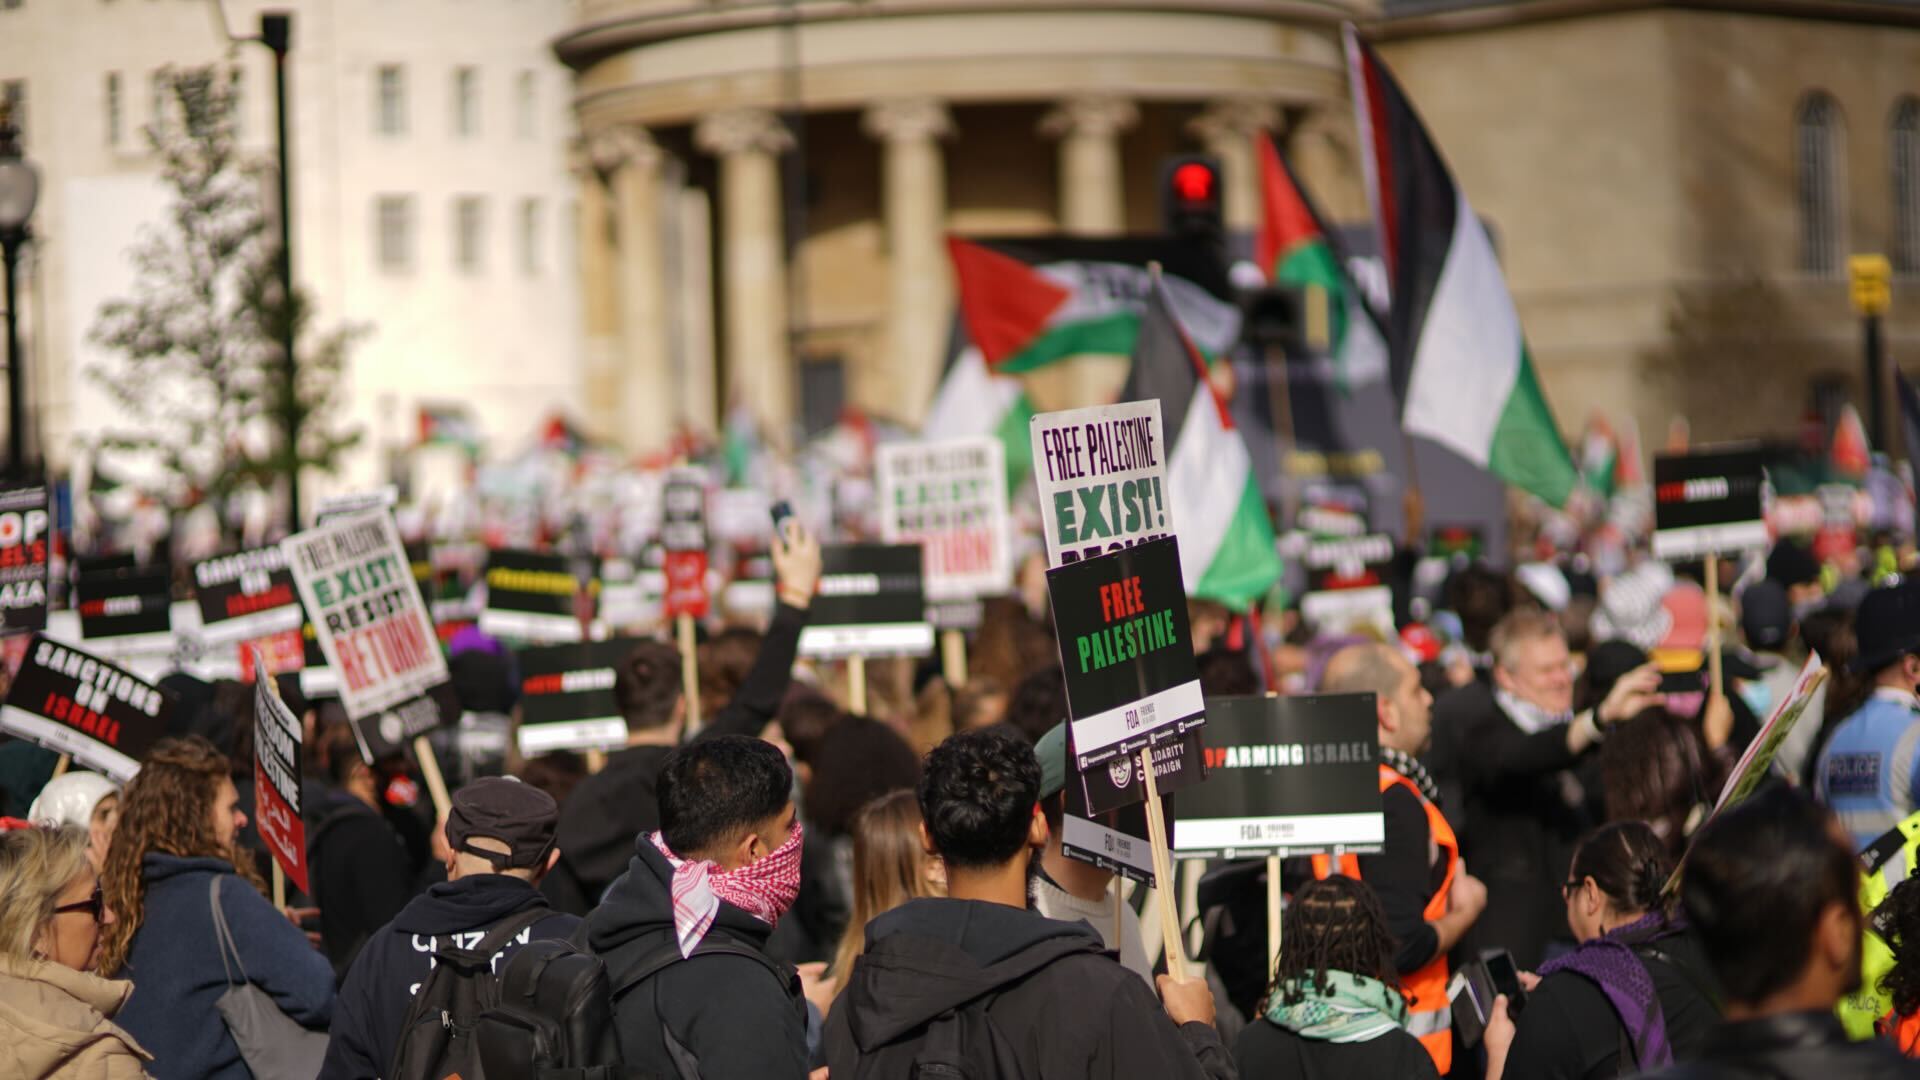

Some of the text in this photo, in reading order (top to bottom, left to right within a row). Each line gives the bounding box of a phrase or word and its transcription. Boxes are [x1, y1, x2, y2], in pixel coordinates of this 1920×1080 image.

[1042, 426, 1085, 482] FREE
[1086, 417, 1157, 476] PALESTINE
[1053, 476, 1165, 546] EXIST!
[1100, 576, 1145, 622] FREE
[1076, 608, 1177, 674] PALESTINE
[34, 642, 163, 717] SANCTIONS
